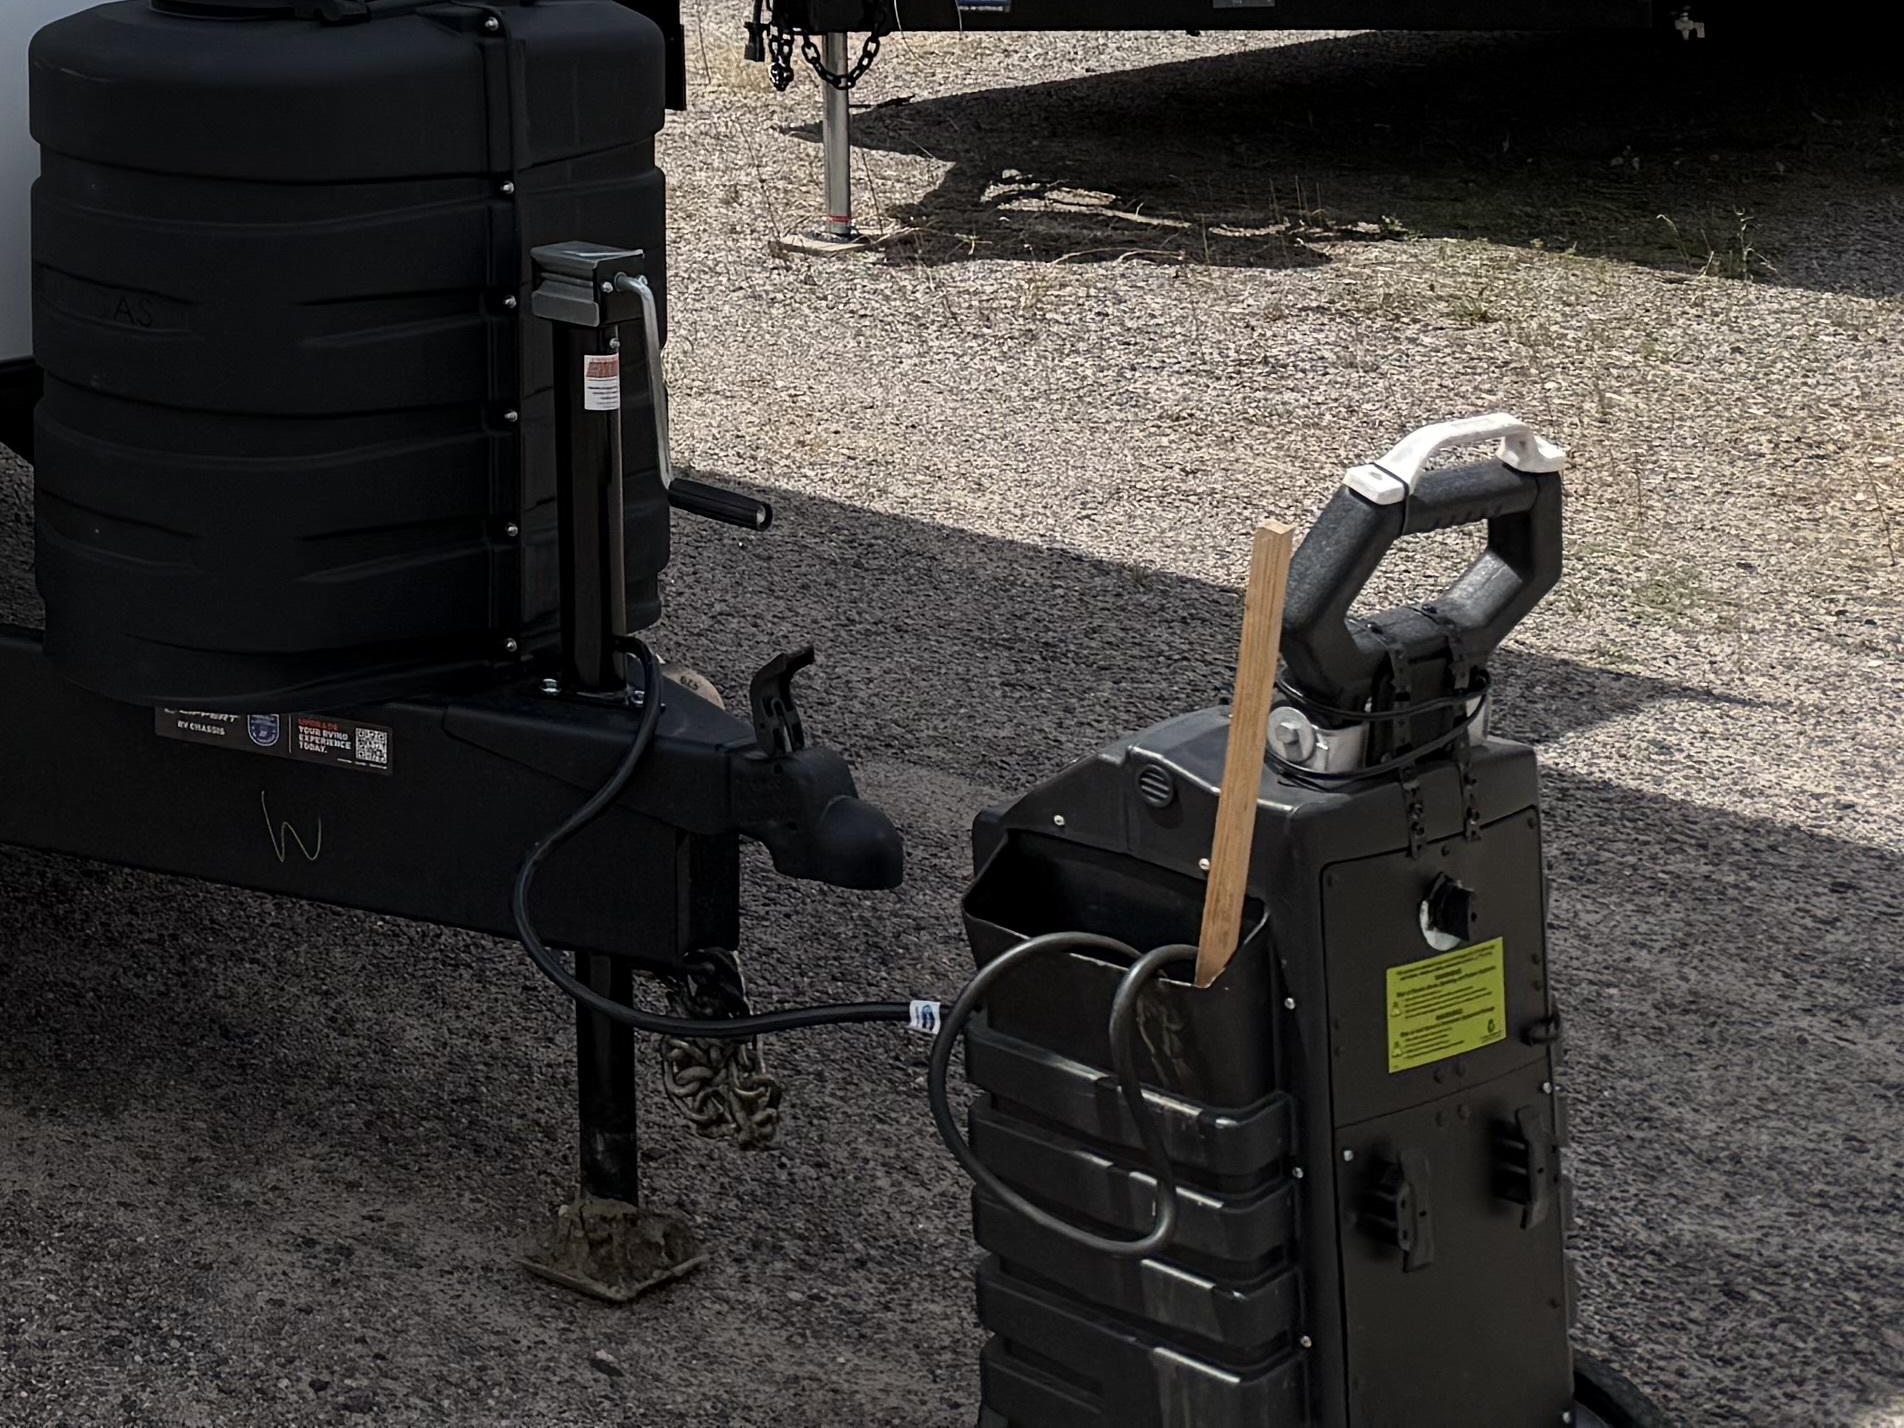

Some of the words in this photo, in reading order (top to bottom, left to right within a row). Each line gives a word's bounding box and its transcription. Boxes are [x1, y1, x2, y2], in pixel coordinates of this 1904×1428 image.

[189, 722, 226, 736] CHASSIS
[298, 725, 321, 737] YOUR
[298, 733, 352, 750] EXPERIENCE
